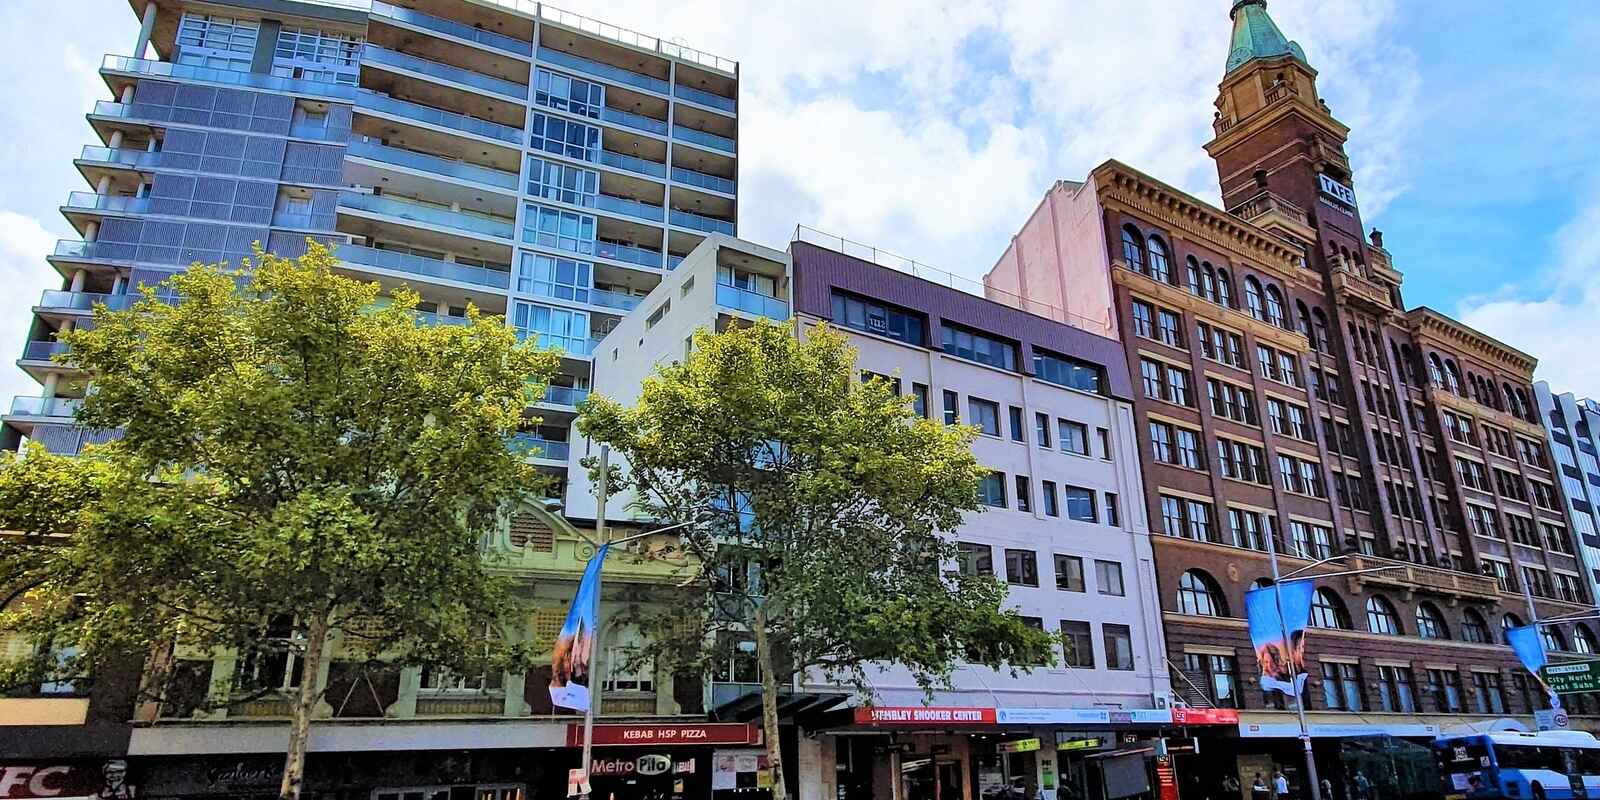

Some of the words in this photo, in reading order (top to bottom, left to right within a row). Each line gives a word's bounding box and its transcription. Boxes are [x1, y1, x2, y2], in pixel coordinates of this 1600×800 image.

[1322, 176, 1352, 204] TAFE
[1547, 676, 1564, 684] City
[1568, 673, 1593, 682] North
[913, 710, 951, 721] SNOOKER
[953, 711, 983, 721] CENTER
[623, 730, 654, 739] KEBAB
[658, 729, 677, 739] HSP
[681, 729, 707, 738] PIZZA
[591, 759, 635, 773] Metro
[0, 766, 71, 796] FC
